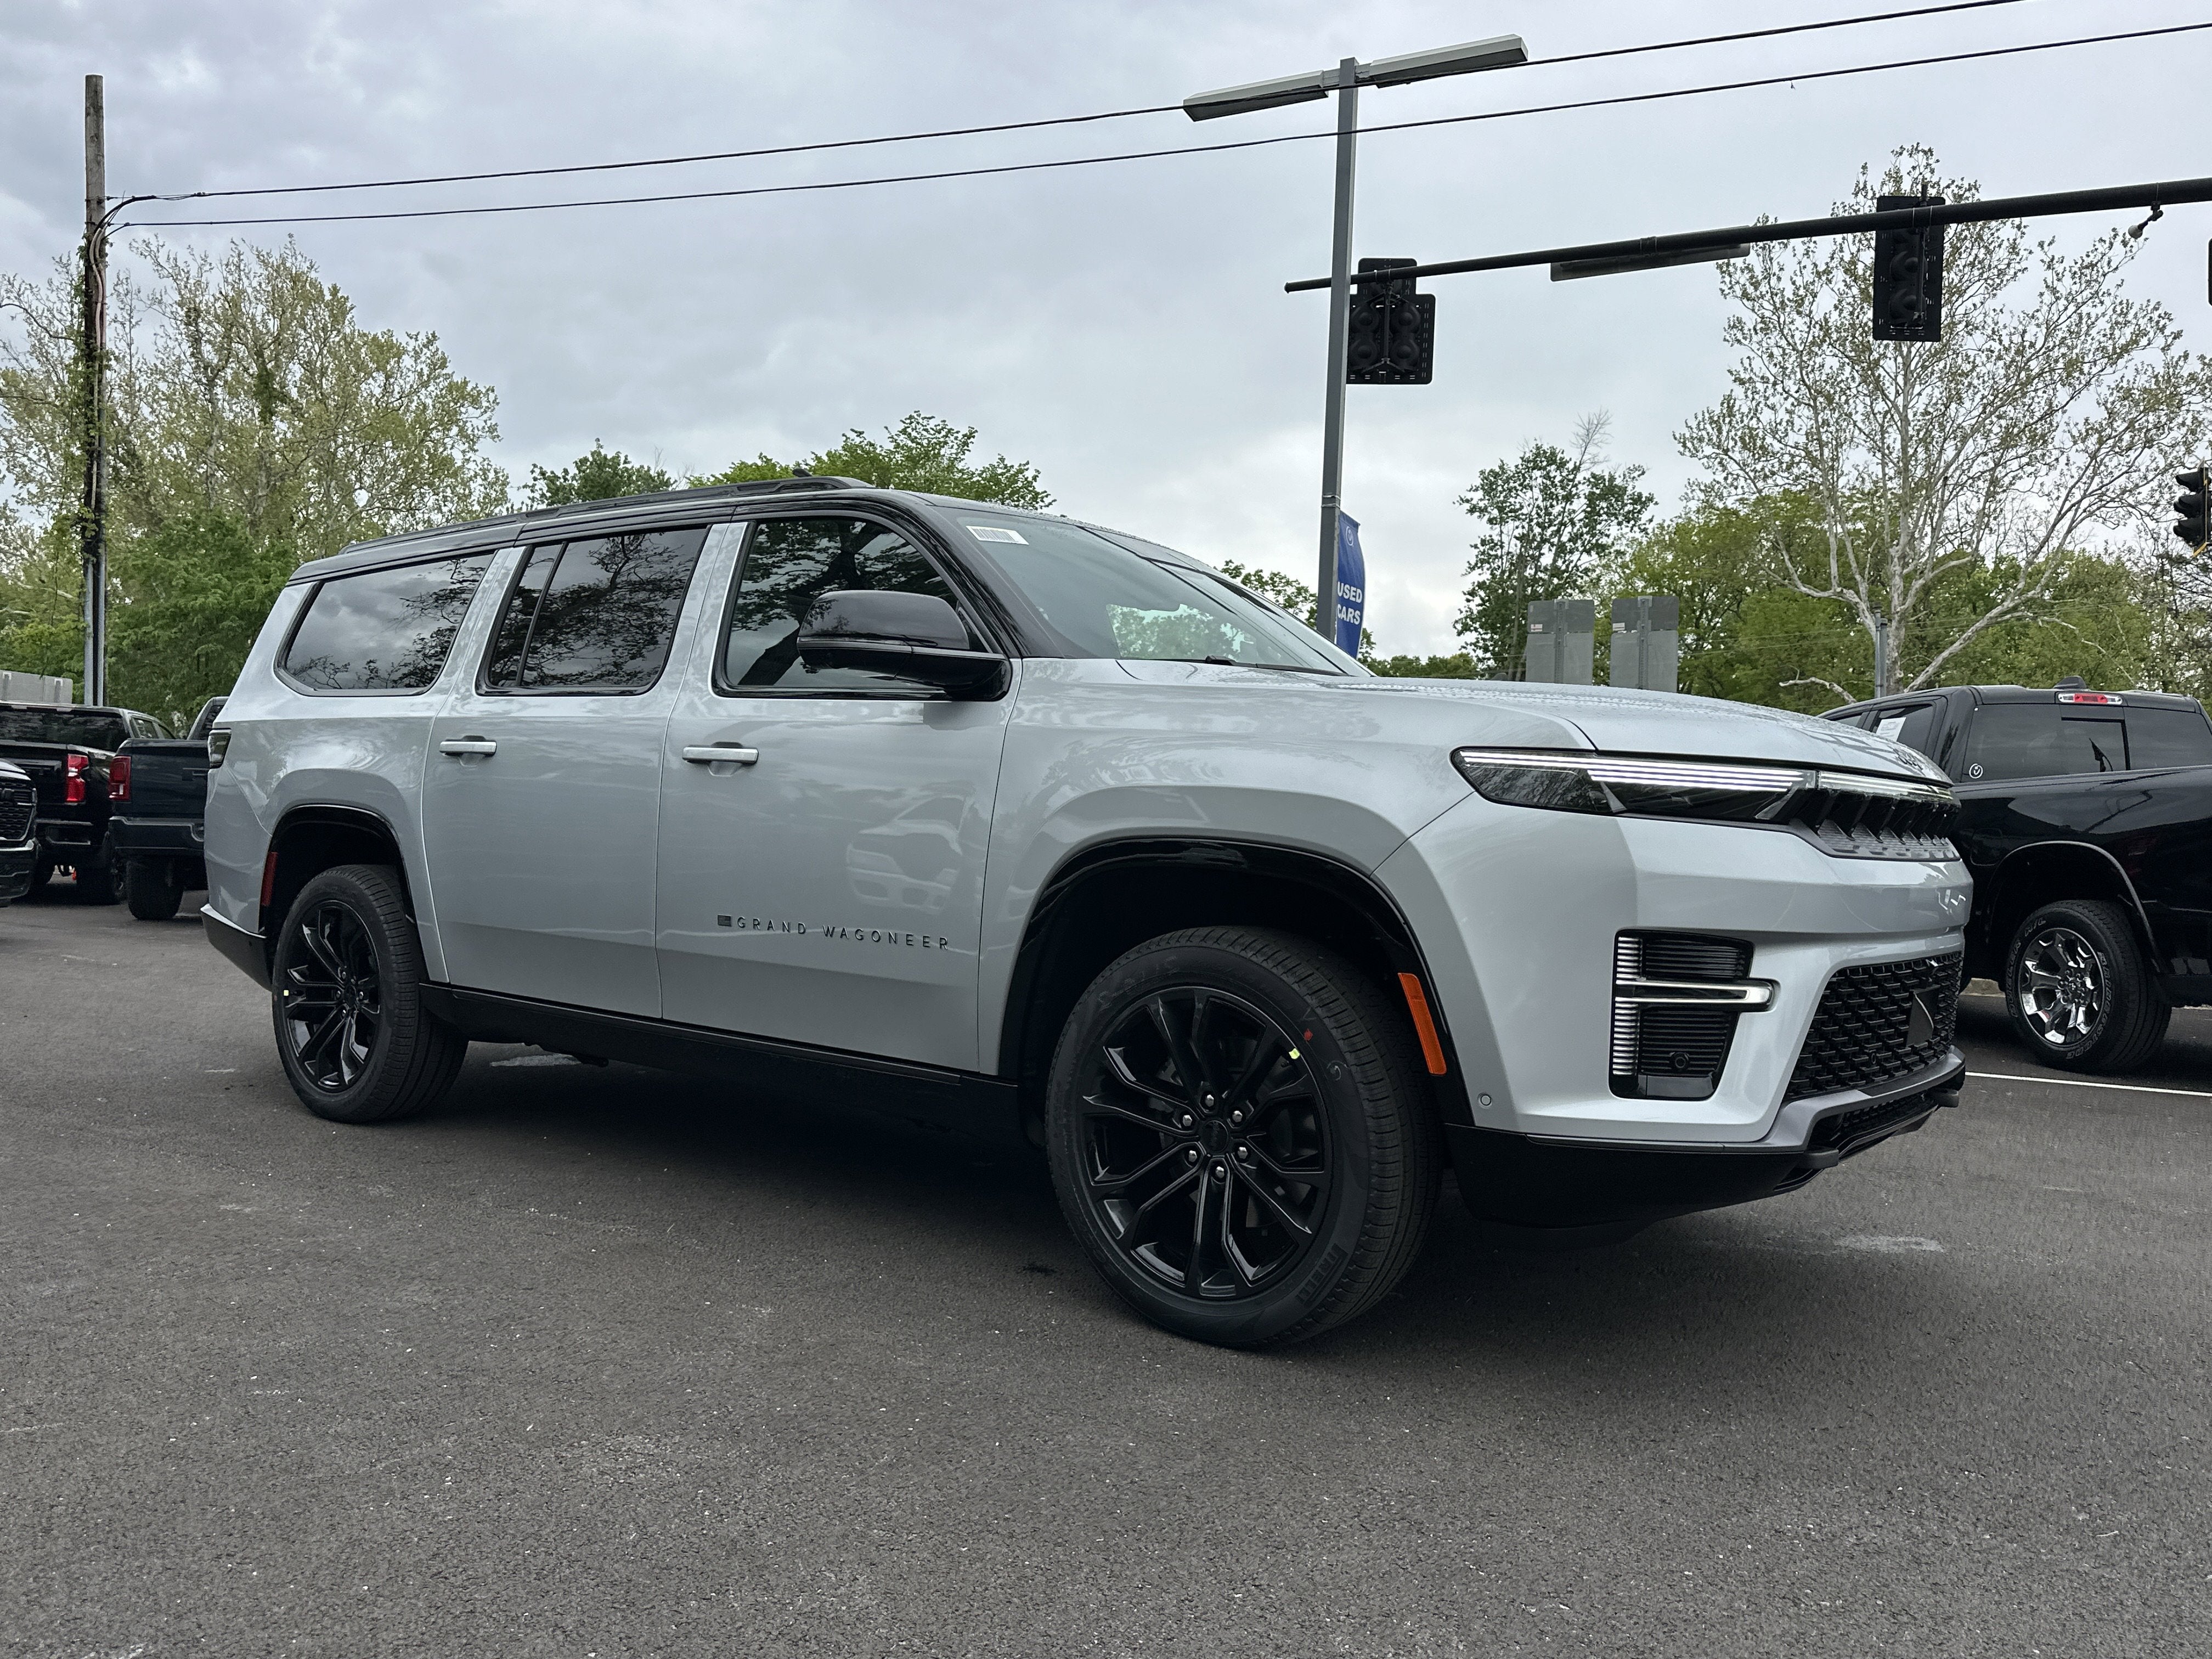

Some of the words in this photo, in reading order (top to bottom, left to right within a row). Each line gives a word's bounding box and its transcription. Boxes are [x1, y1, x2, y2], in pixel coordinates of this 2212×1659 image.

[1337, 581, 1363, 603] USED
[1337, 603, 1361, 625] CARS
[737, 916, 807, 934] GRAND
[822, 924, 949, 950] WAGONEER
